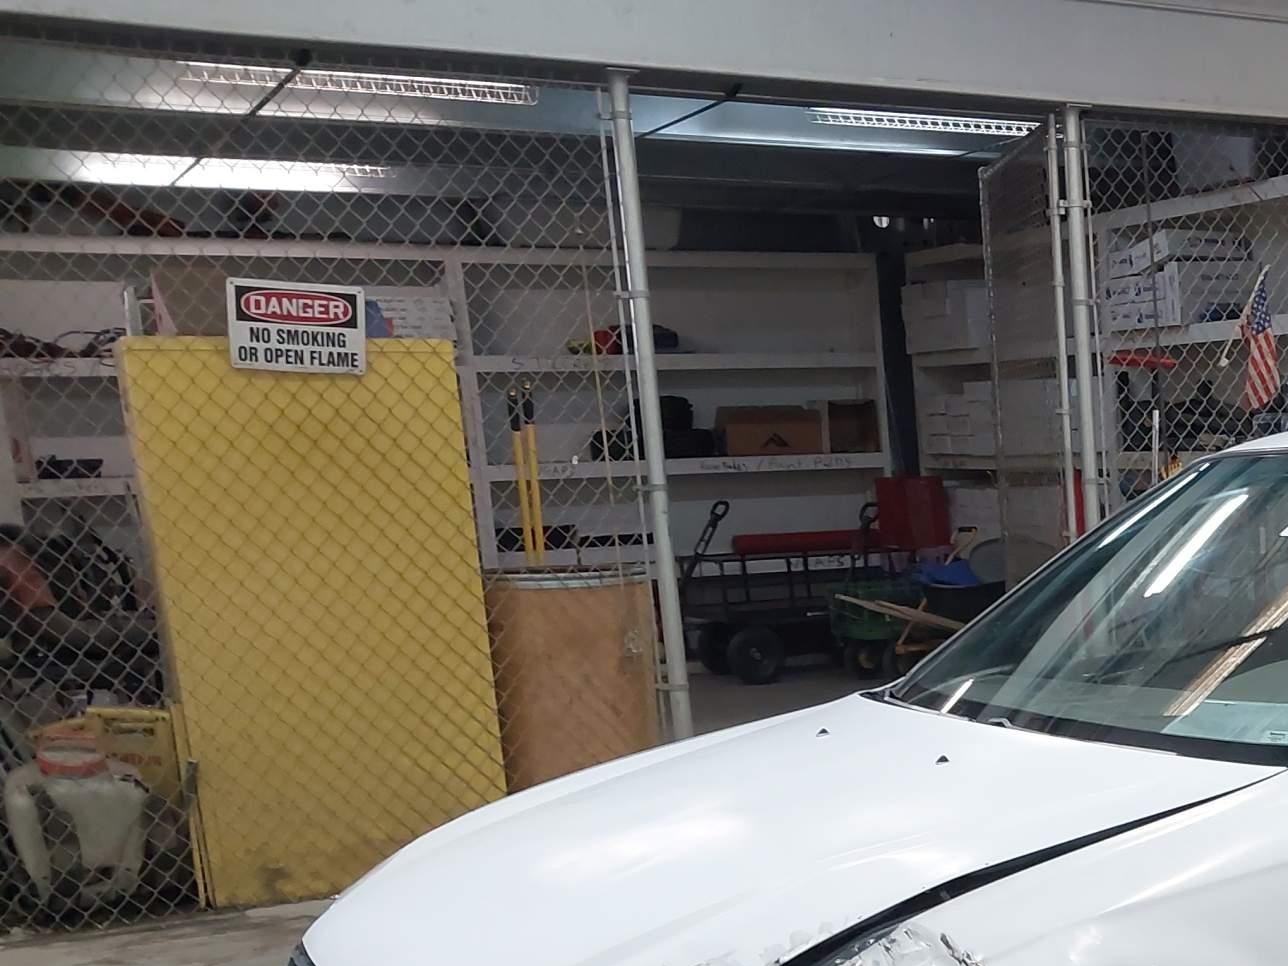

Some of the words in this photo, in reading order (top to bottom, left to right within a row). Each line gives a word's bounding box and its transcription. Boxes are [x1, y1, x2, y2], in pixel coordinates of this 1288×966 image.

[249, 295, 345, 319] DANGER
[249, 326, 271, 344] NO
[276, 328, 347, 348] SMOKING
[238, 346, 258, 363] OR
[264, 348, 304, 365] OPEN
[310, 350, 359, 368] FLAME
